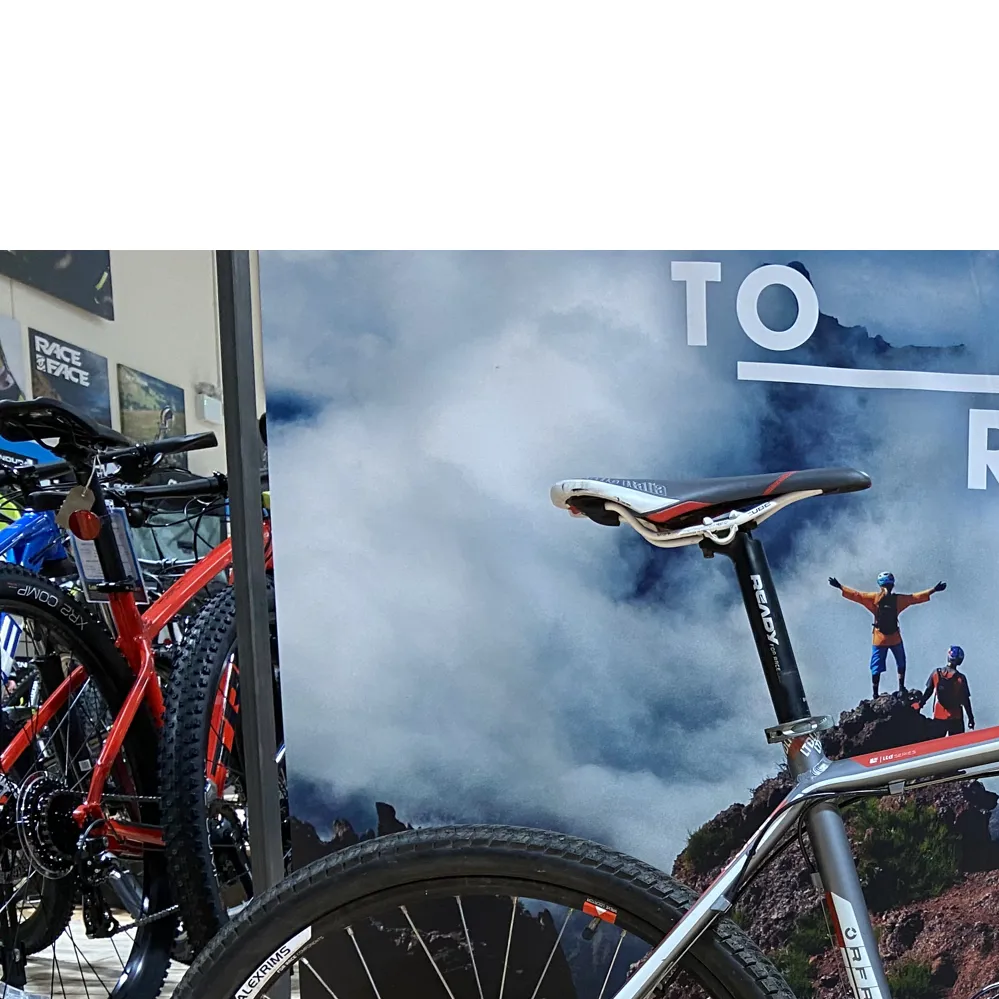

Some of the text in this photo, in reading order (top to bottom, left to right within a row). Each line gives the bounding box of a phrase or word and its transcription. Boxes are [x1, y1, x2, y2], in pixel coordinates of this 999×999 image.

[670, 261, 820, 351] TO
[34, 335, 82, 367] RACE
[45, 357, 91, 388] FACE
[16, 585, 89, 631] XR2 COMP
[750, 574, 780, 646] READY
